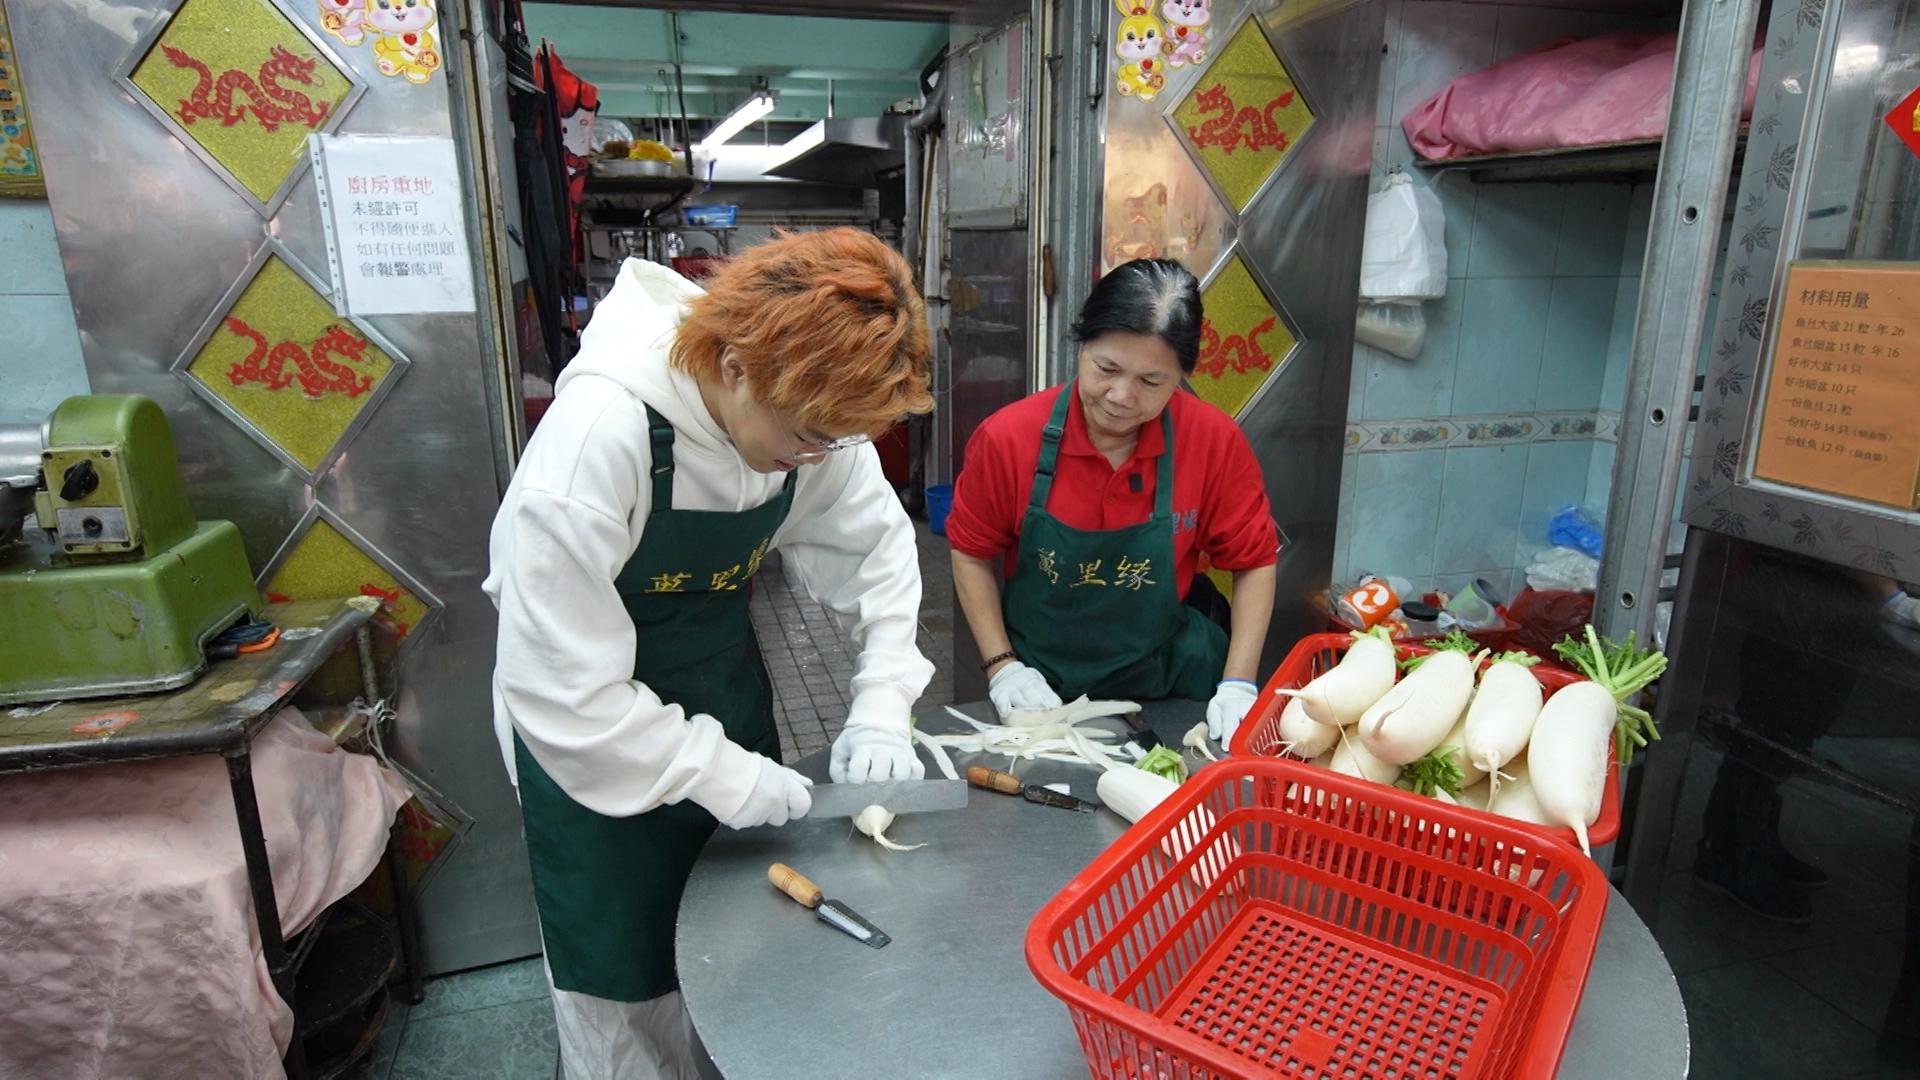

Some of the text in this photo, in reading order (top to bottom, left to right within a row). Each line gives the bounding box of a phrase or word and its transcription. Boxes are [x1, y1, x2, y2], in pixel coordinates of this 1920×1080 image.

[352, 200, 419, 216] 未經許可
[356, 241, 456, 256] 如有任何問題
[360, 261, 445, 277] 會報警處理
[1800, 287, 1870, 309] 材料用量
[1842, 321, 1853, 332] 21
[1858, 322, 1870, 334] 粒
[1891, 325, 1905, 337] 26
[1887, 346, 1899, 358] 16
[1831, 382, 1843, 394] 10
[1826, 402, 1838, 414] 21
[1824, 421, 1835, 432] 14
[1821, 440, 1833, 452] 12
